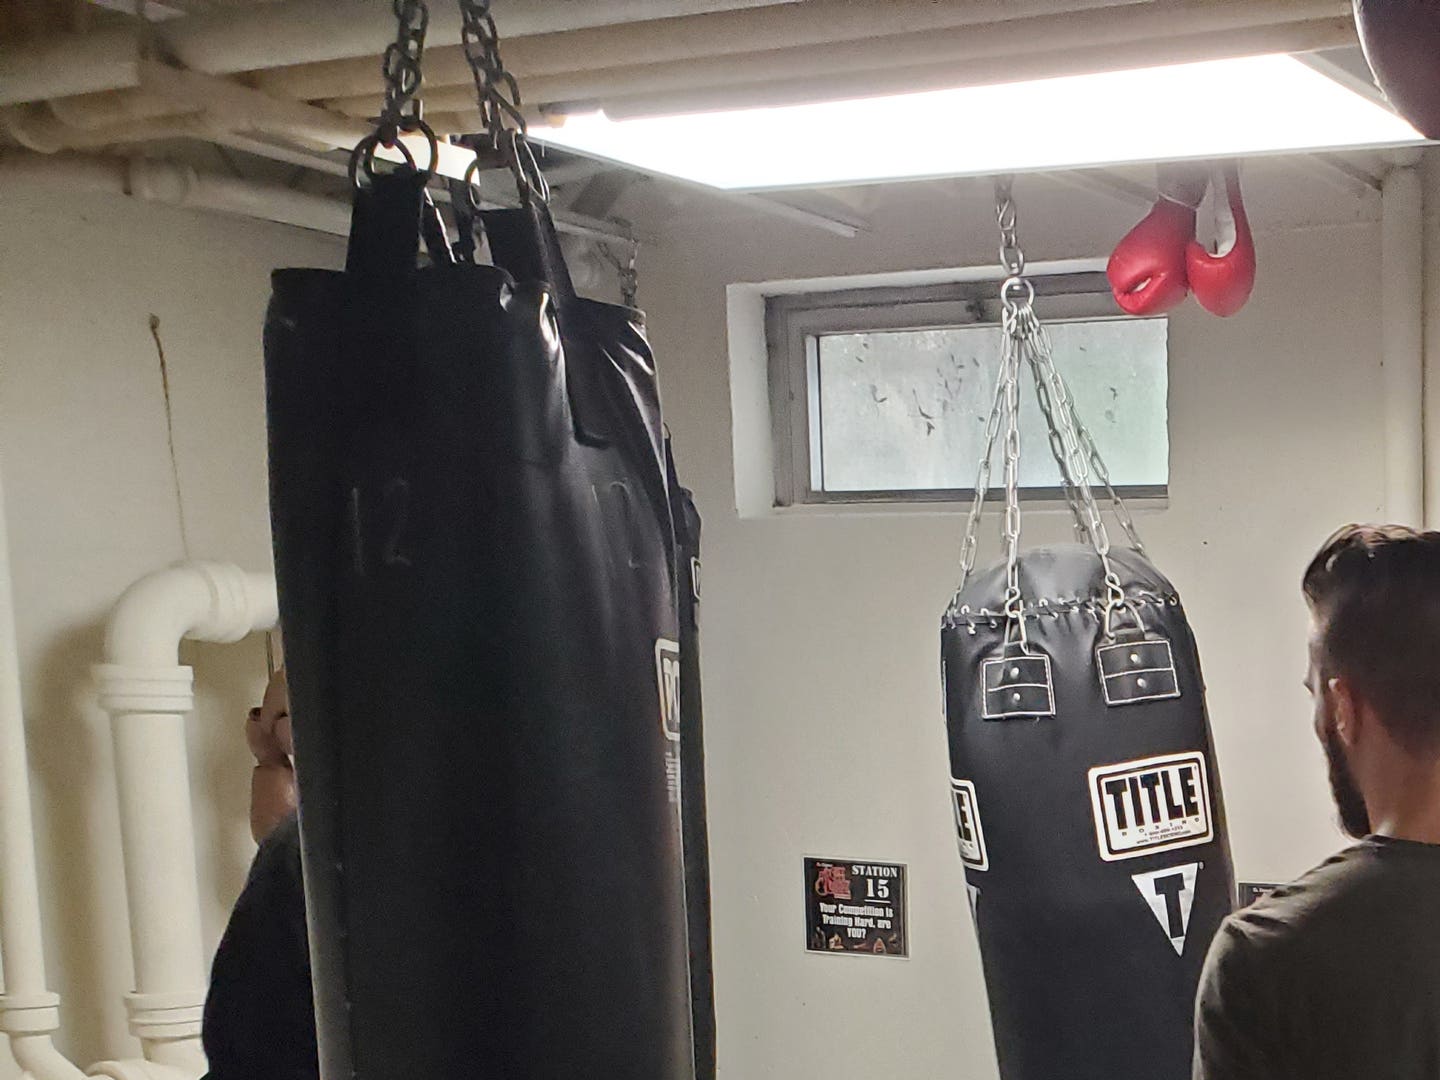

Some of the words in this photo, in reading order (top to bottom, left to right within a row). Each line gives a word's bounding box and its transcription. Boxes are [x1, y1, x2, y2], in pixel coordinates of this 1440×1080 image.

[1105, 767, 1200, 830] TITLE
[852, 865, 898, 877] STATION
[866, 878, 889, 898] 15
[819, 902, 837, 913] Your
[838, 904, 884, 917] Competition
[822, 914, 853, 926] Training
[877, 919, 892, 929] are
